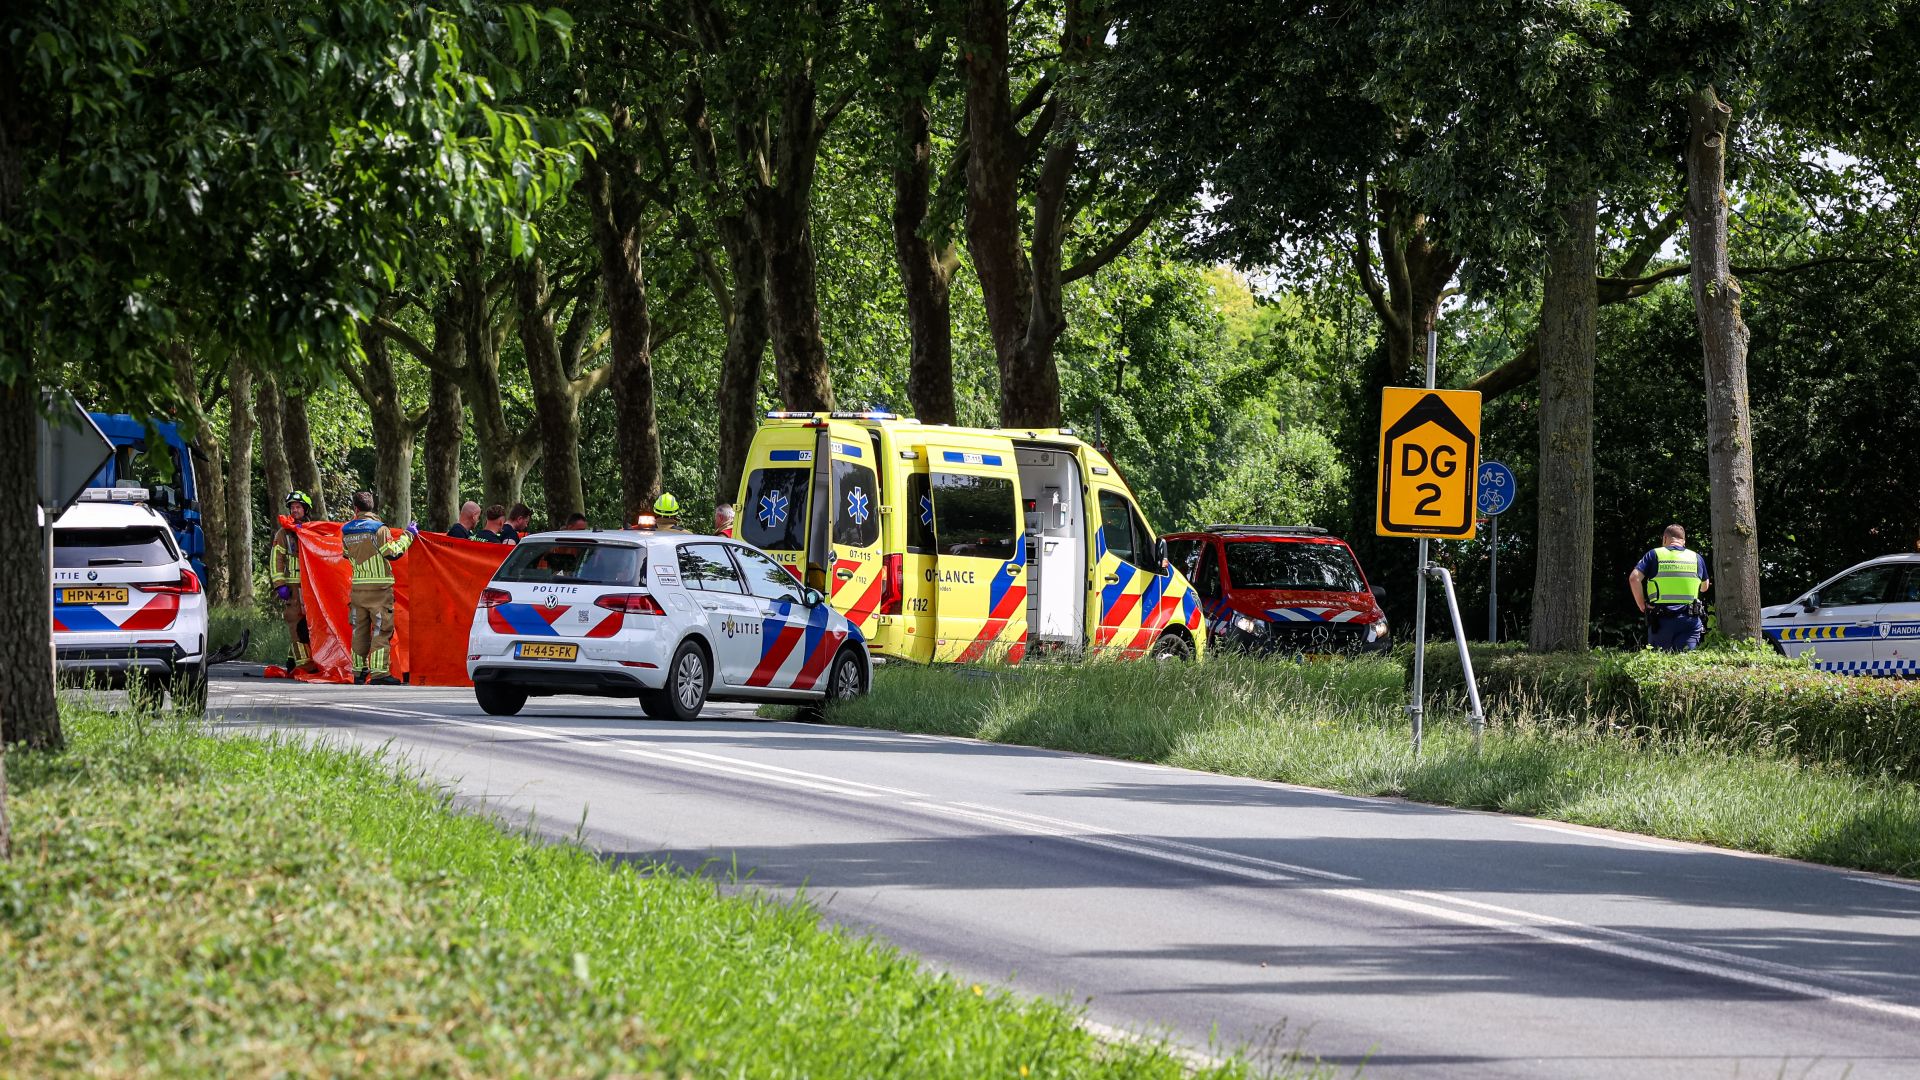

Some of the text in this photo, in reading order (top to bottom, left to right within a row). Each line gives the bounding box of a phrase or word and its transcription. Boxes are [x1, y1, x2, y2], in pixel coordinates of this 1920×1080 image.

[1401, 443, 1457, 478] DG
[1414, 482, 1442, 516] 2
[849, 549, 871, 561] 07-115
[54, 572, 80, 580] ITIE
[67, 590, 124, 601] HPN-41-G
[532, 586, 578, 594] POLITIE
[721, 619, 759, 639] POLITIE
[523, 645, 571, 657] H-445-FK
